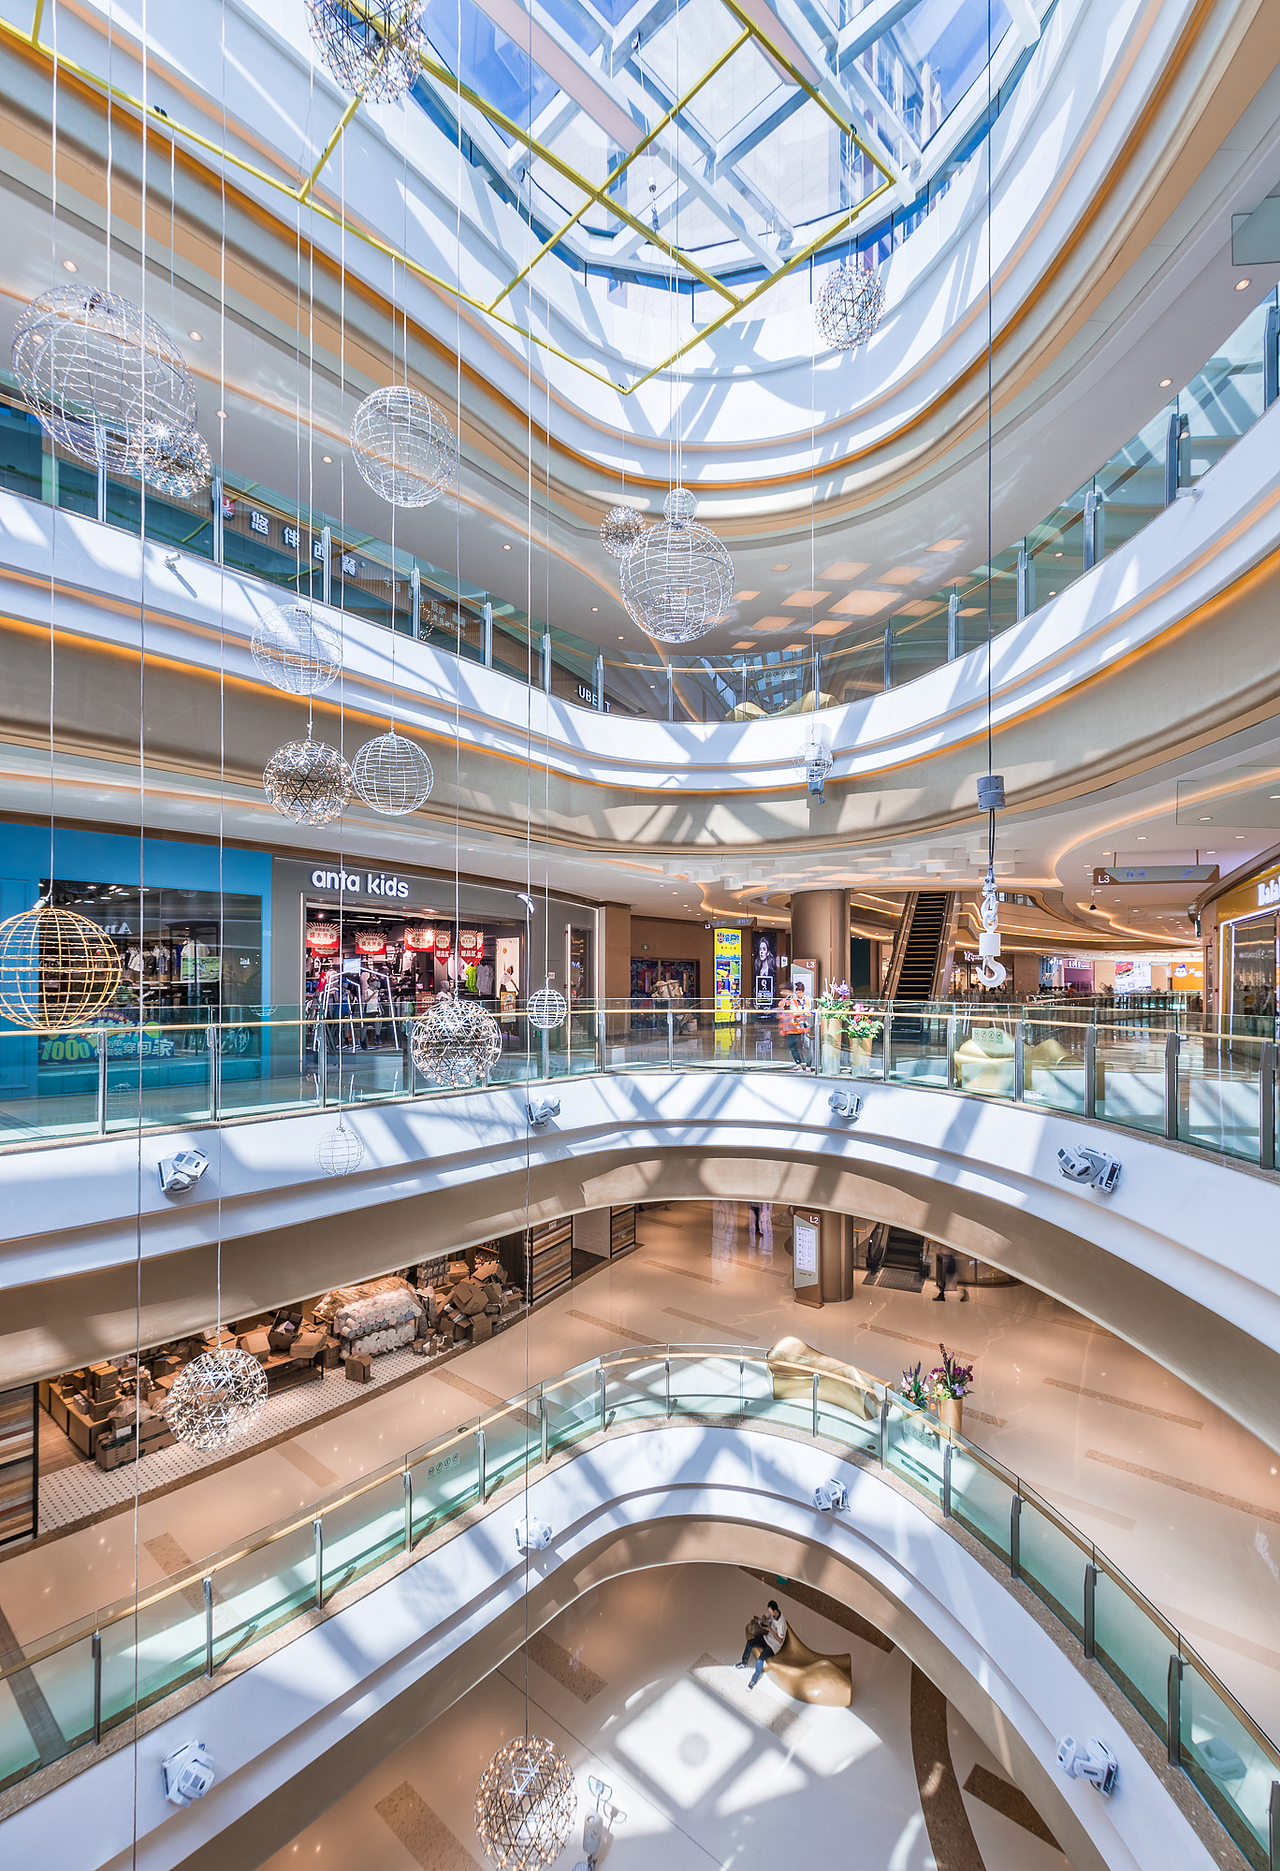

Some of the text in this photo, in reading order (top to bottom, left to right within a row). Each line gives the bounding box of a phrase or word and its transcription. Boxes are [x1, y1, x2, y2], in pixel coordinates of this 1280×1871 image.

[578, 685, 611, 713] UBET
[311, 870, 409, 898] anta kids
[1098, 875, 1110, 883] L3
[41, 1039, 91, 1061] 1000
[809, 1215, 819, 1224] L2
